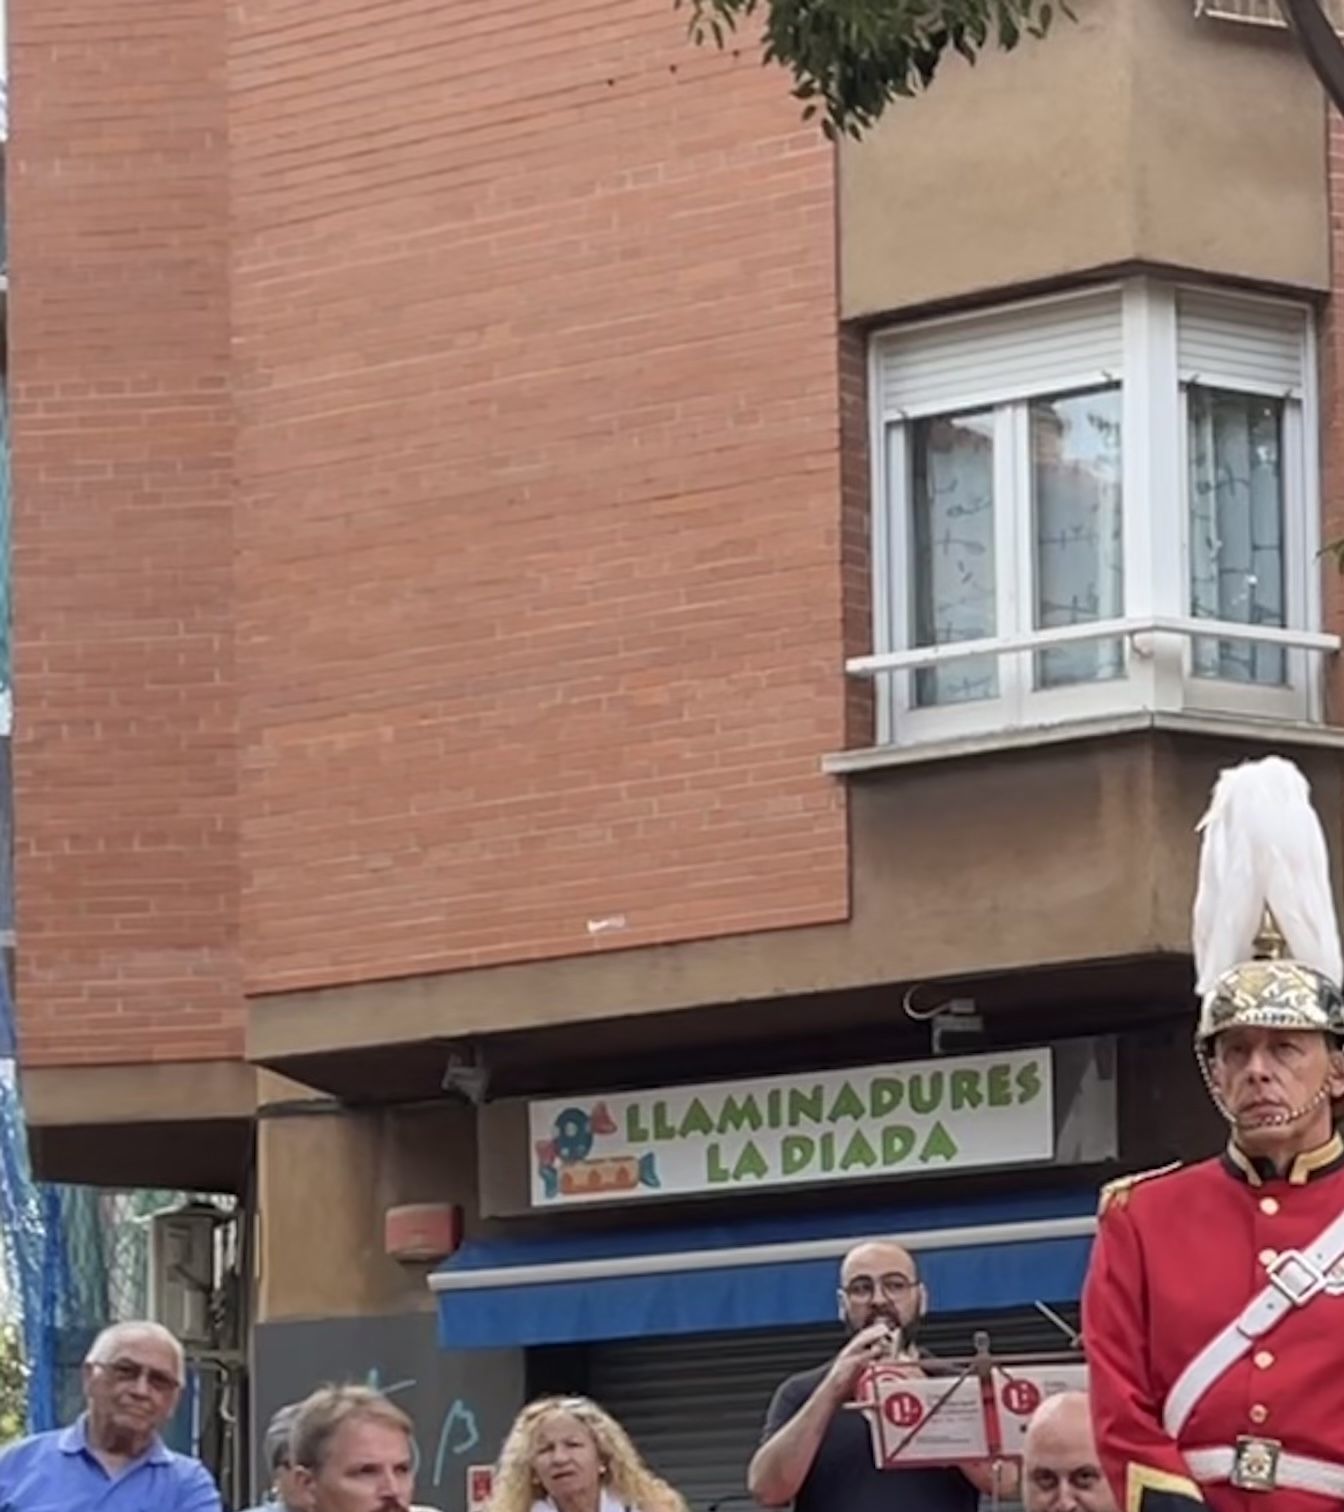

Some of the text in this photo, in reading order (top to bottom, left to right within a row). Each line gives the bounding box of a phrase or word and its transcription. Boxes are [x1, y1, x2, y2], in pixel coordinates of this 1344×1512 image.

[625, 1060, 1042, 1144] LLAMINADURES
[706, 1120, 958, 1184] LA DIADA
